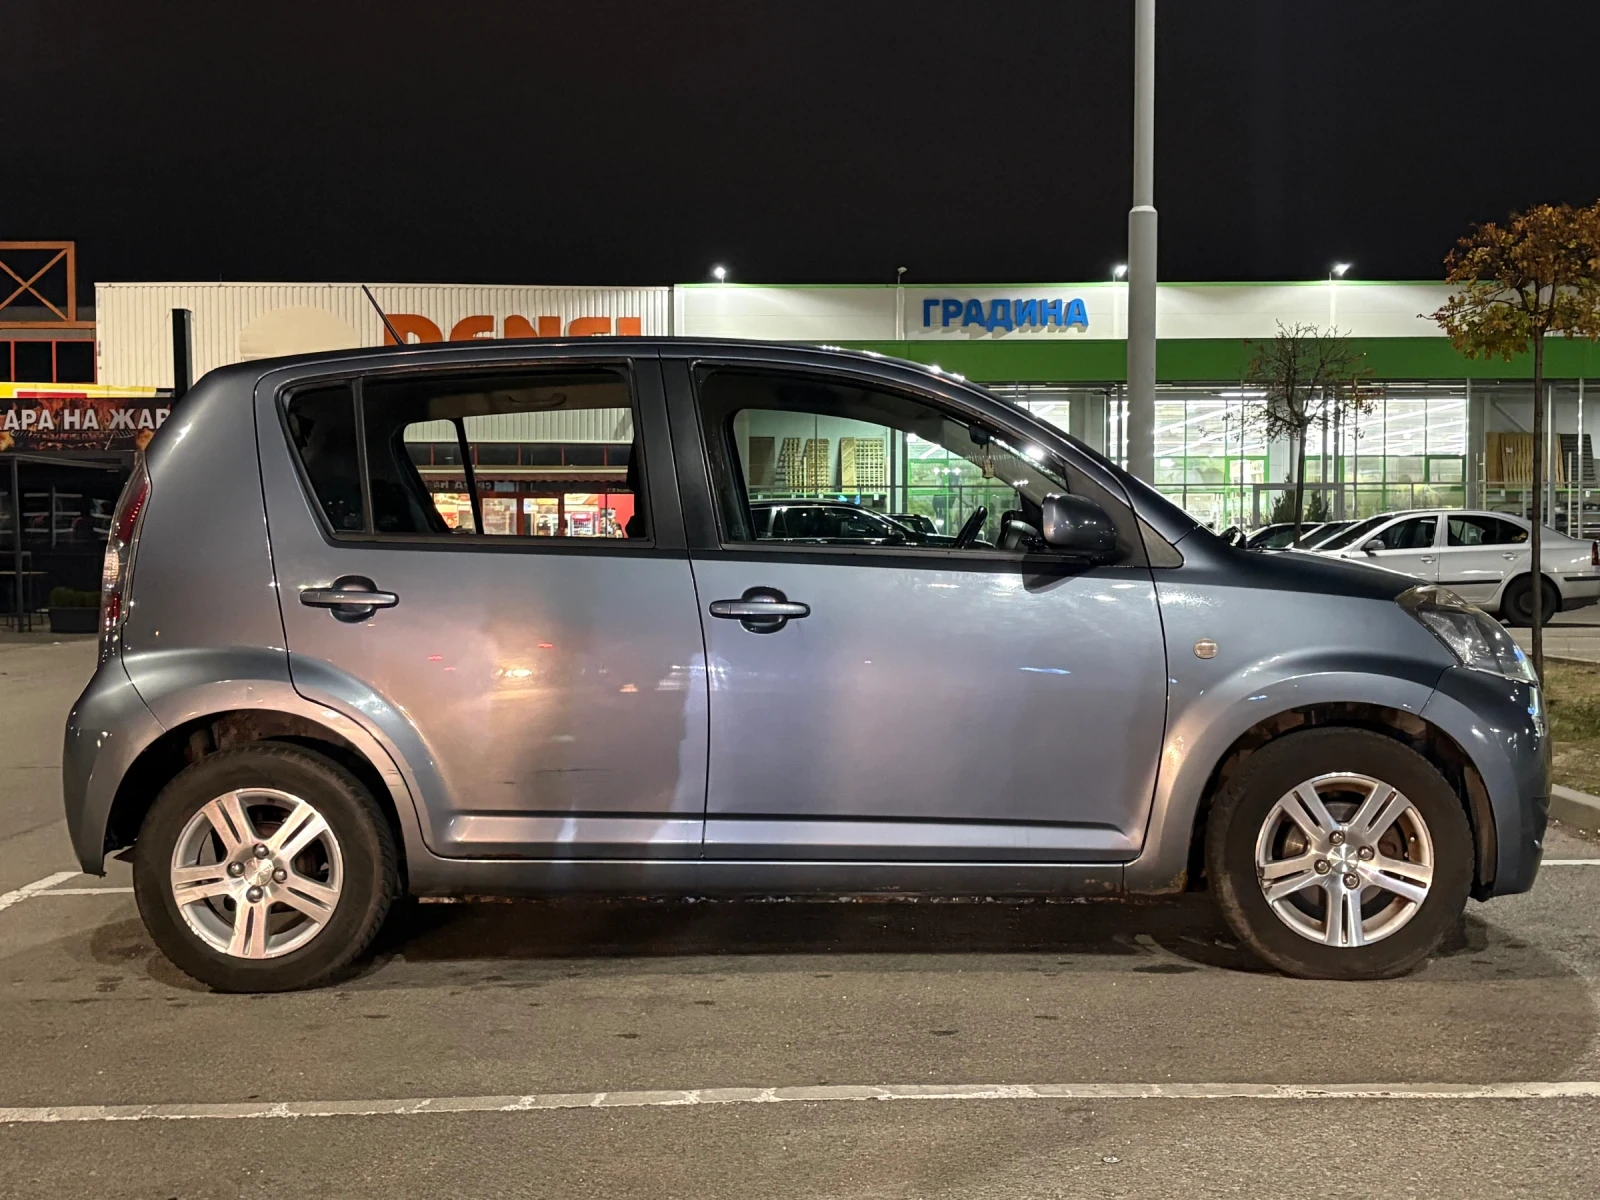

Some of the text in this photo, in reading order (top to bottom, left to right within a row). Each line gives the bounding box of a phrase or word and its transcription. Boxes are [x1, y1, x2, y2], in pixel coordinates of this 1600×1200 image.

[923, 298, 1088, 332] ГРАДИНА
[0, 408, 54, 430] АРА
[63, 408, 99, 430] НА
